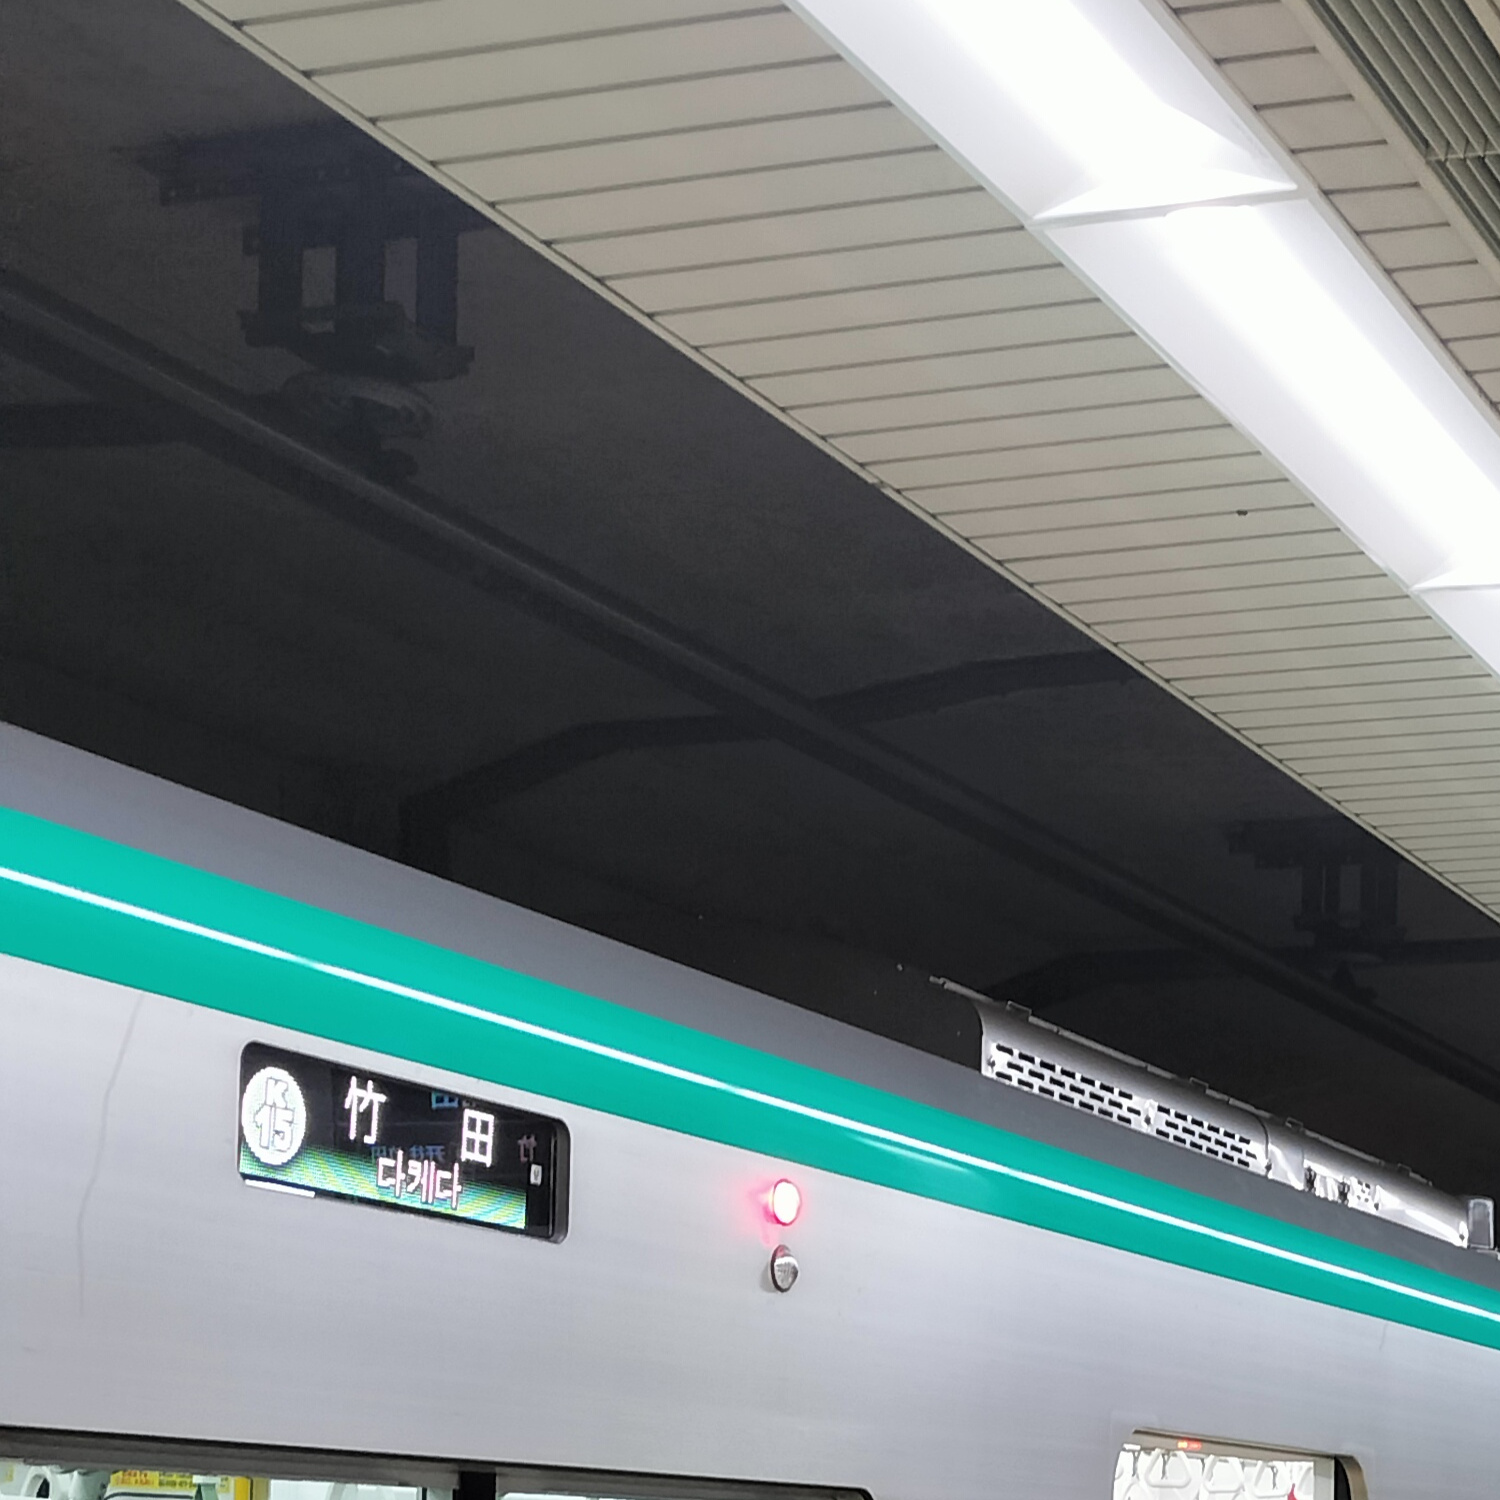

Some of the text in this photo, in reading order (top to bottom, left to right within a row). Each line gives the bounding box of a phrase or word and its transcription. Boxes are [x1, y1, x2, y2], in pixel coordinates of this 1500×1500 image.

[265, 1076, 289, 1107] K
[254, 1103, 296, 1153] 15
[376, 1148, 463, 1210] 다케다
